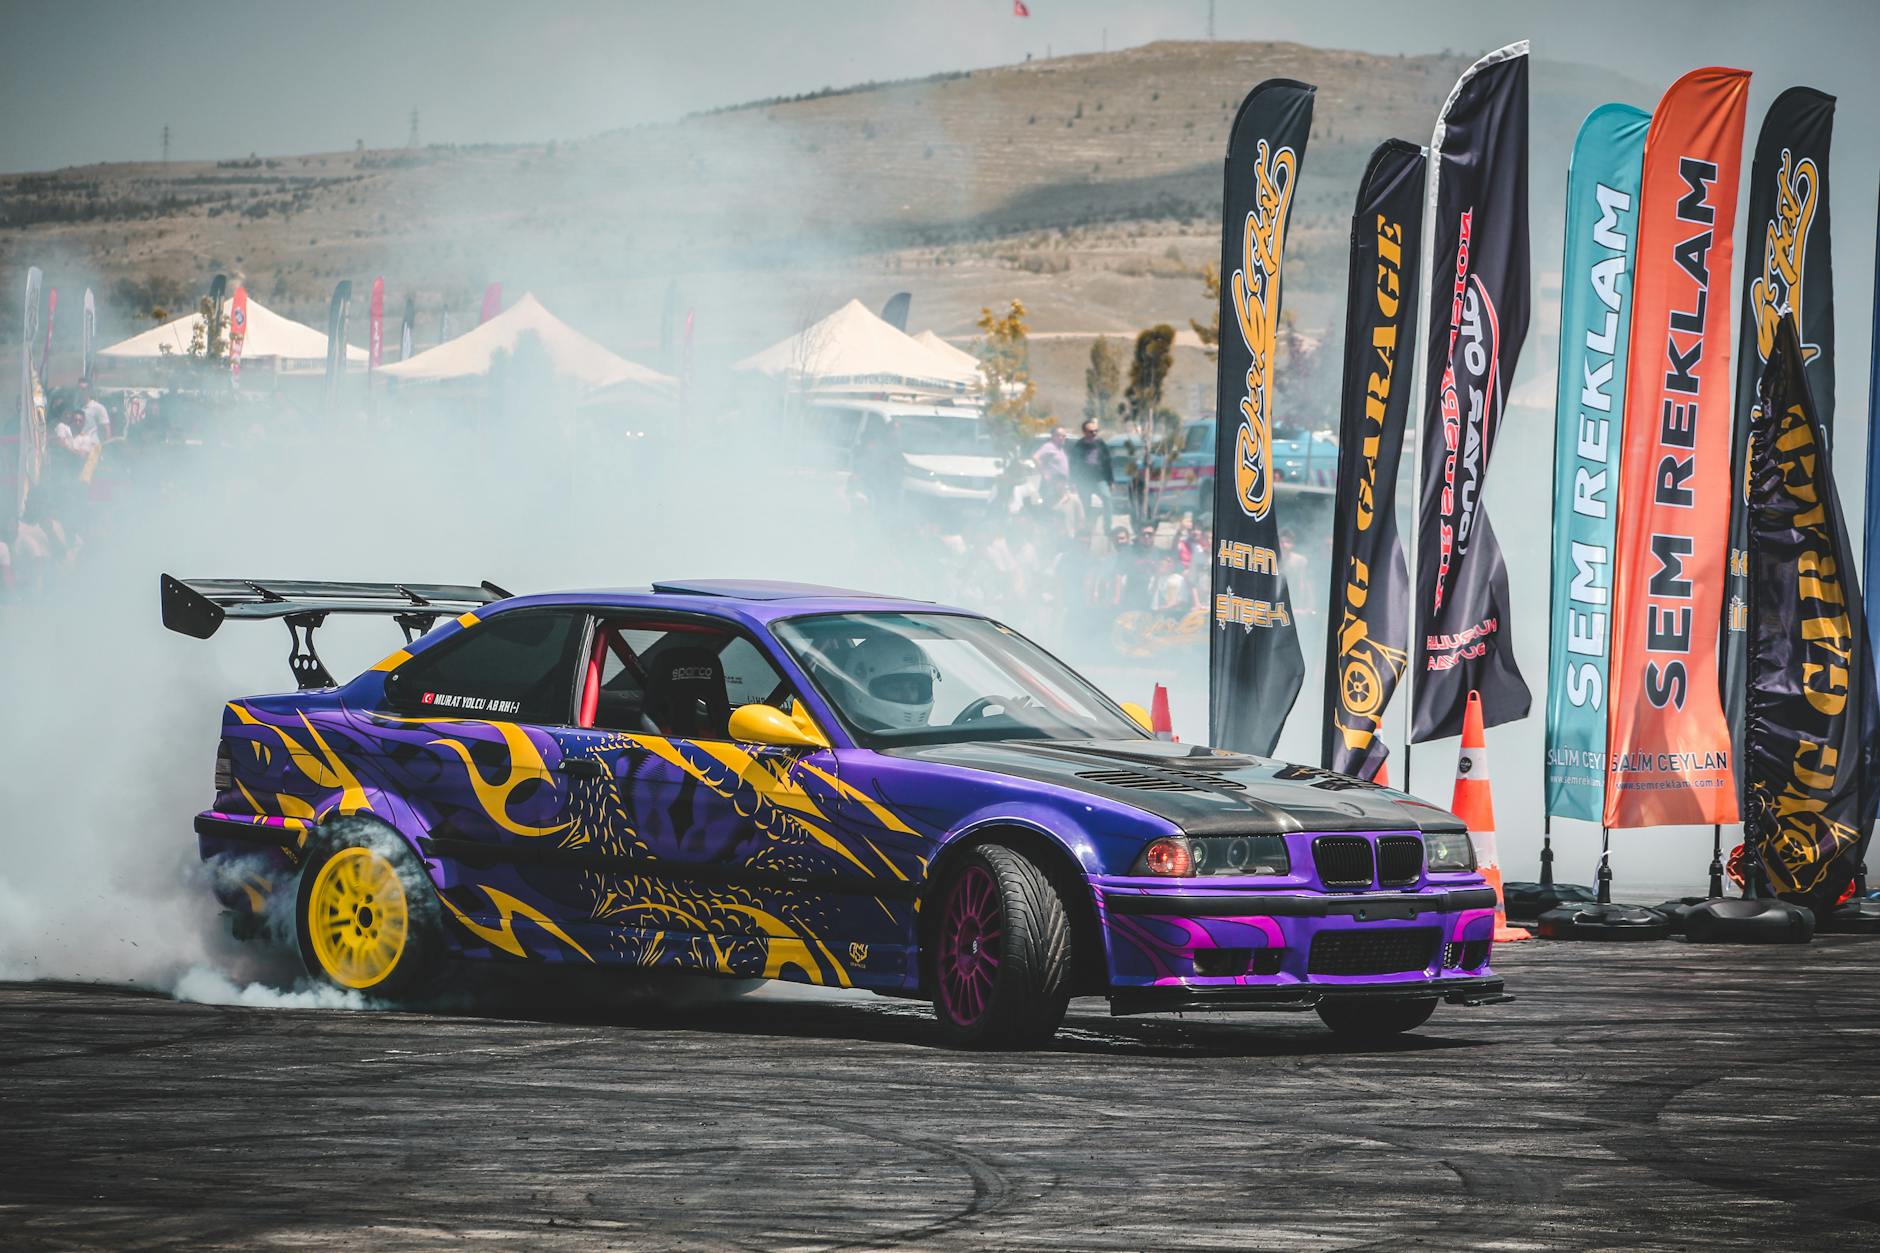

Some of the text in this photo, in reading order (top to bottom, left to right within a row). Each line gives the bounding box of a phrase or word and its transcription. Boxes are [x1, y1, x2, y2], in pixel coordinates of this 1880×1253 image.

[1356, 213, 1402, 531] GARAGE
[1566, 182, 1632, 712] SEM REKLAM
[1644, 156, 1719, 712] SEM REKLAM
[1775, 404, 1853, 717] GARAGE
[434, 693, 462, 708] MURAT
[462, 697, 486, 710] YOLCU
[486, 699, 499, 711] AB
[671, 667, 713, 681] sparco
[1582, 751, 1606, 770] CEY
[1657, 751, 1728, 772] CEYLAN
